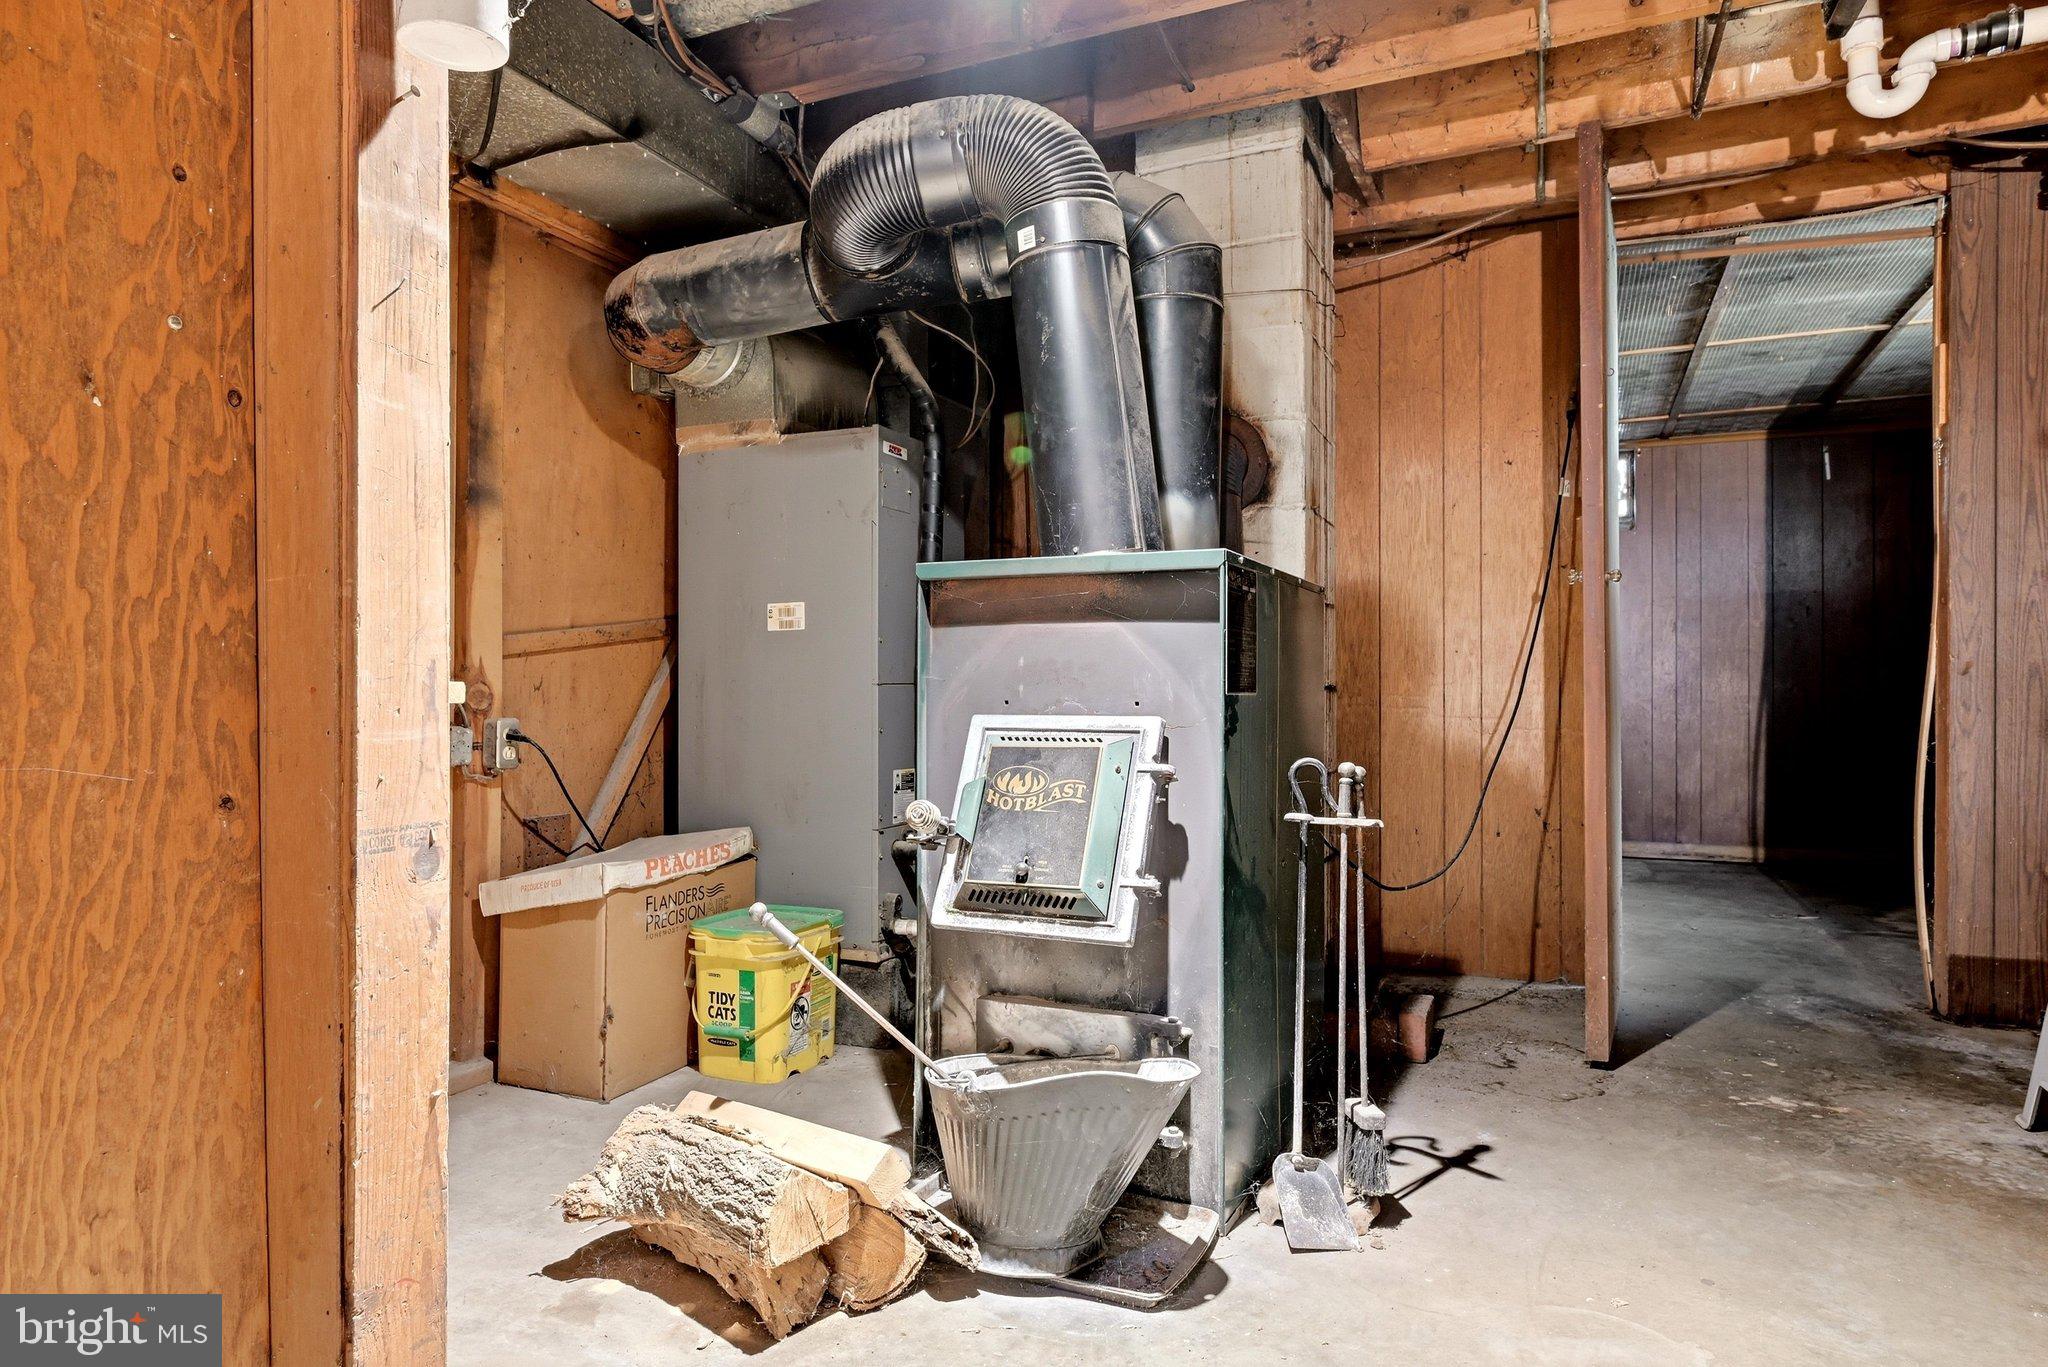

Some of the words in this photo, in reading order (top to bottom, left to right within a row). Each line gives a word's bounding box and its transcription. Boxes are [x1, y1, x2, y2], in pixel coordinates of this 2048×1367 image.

[986, 783, 1087, 811] HOTBLAST
[643, 841, 732, 880] PEACHES
[645, 885, 705, 912] FLANDERS
[708, 990, 736, 1006] TIDY
[707, 1005, 736, 1021] CATS
